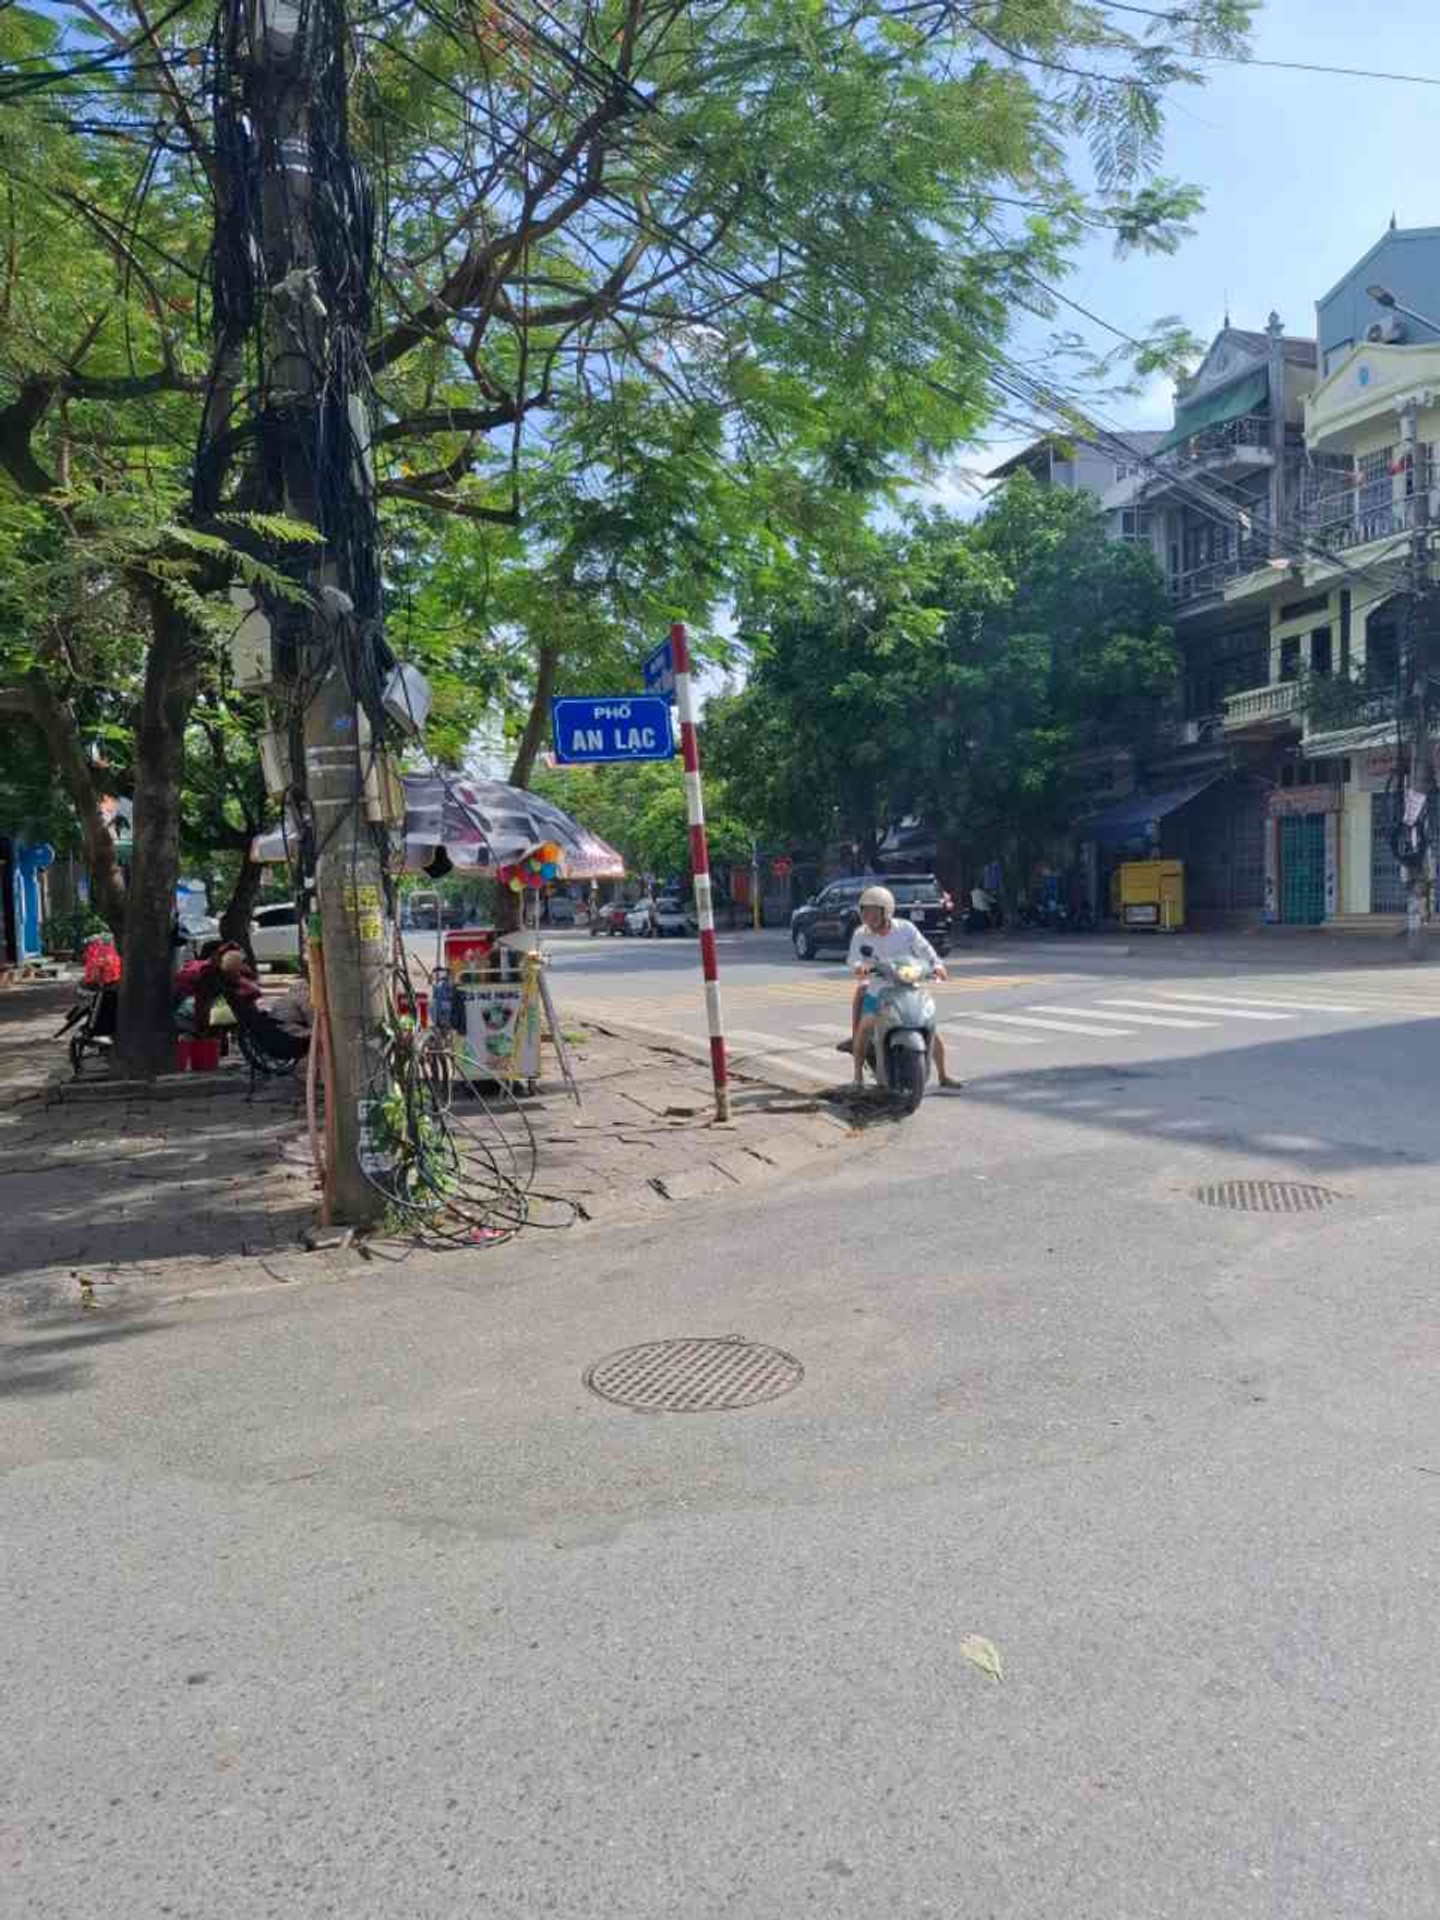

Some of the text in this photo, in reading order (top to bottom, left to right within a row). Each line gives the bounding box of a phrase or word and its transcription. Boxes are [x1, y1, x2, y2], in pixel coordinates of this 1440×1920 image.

[594, 704, 631, 719] PHỐ
[573, 728, 657, 753] AN LẠC
